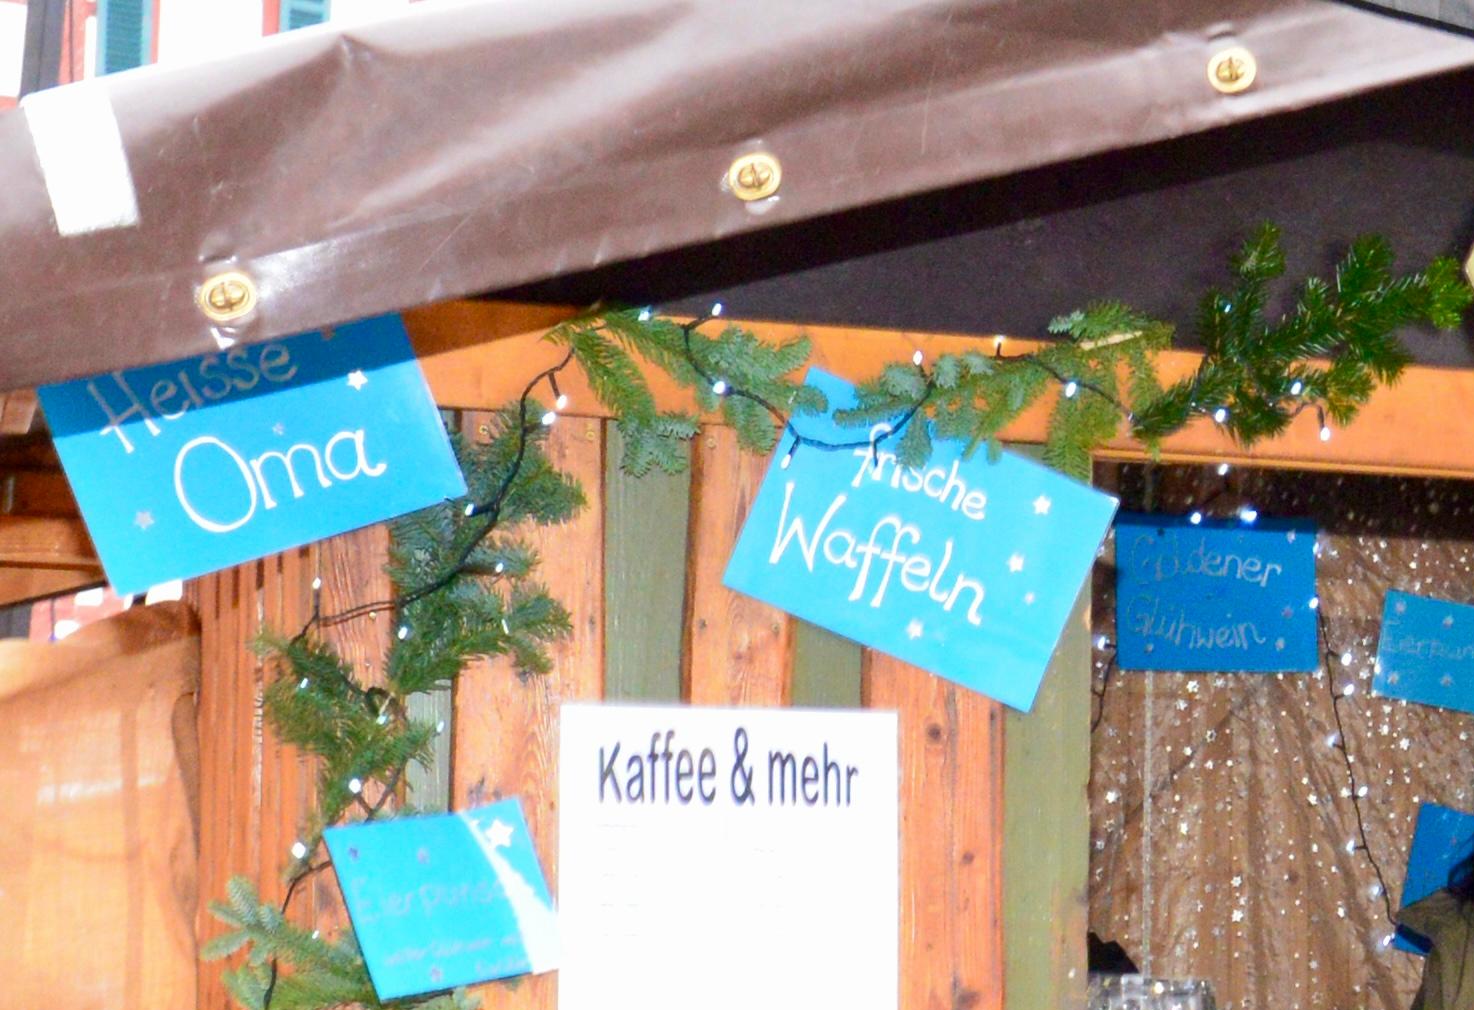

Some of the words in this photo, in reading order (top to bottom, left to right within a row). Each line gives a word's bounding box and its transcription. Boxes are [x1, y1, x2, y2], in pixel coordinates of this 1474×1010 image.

[87, 342, 297, 453] Heisse
[174, 428, 387, 533] Oma
[768, 481, 985, 626] Waffeln
[599, 730, 716, 804] Kaffee
[731, 727, 754, 805] &
[768, 742, 859, 807] mehr
